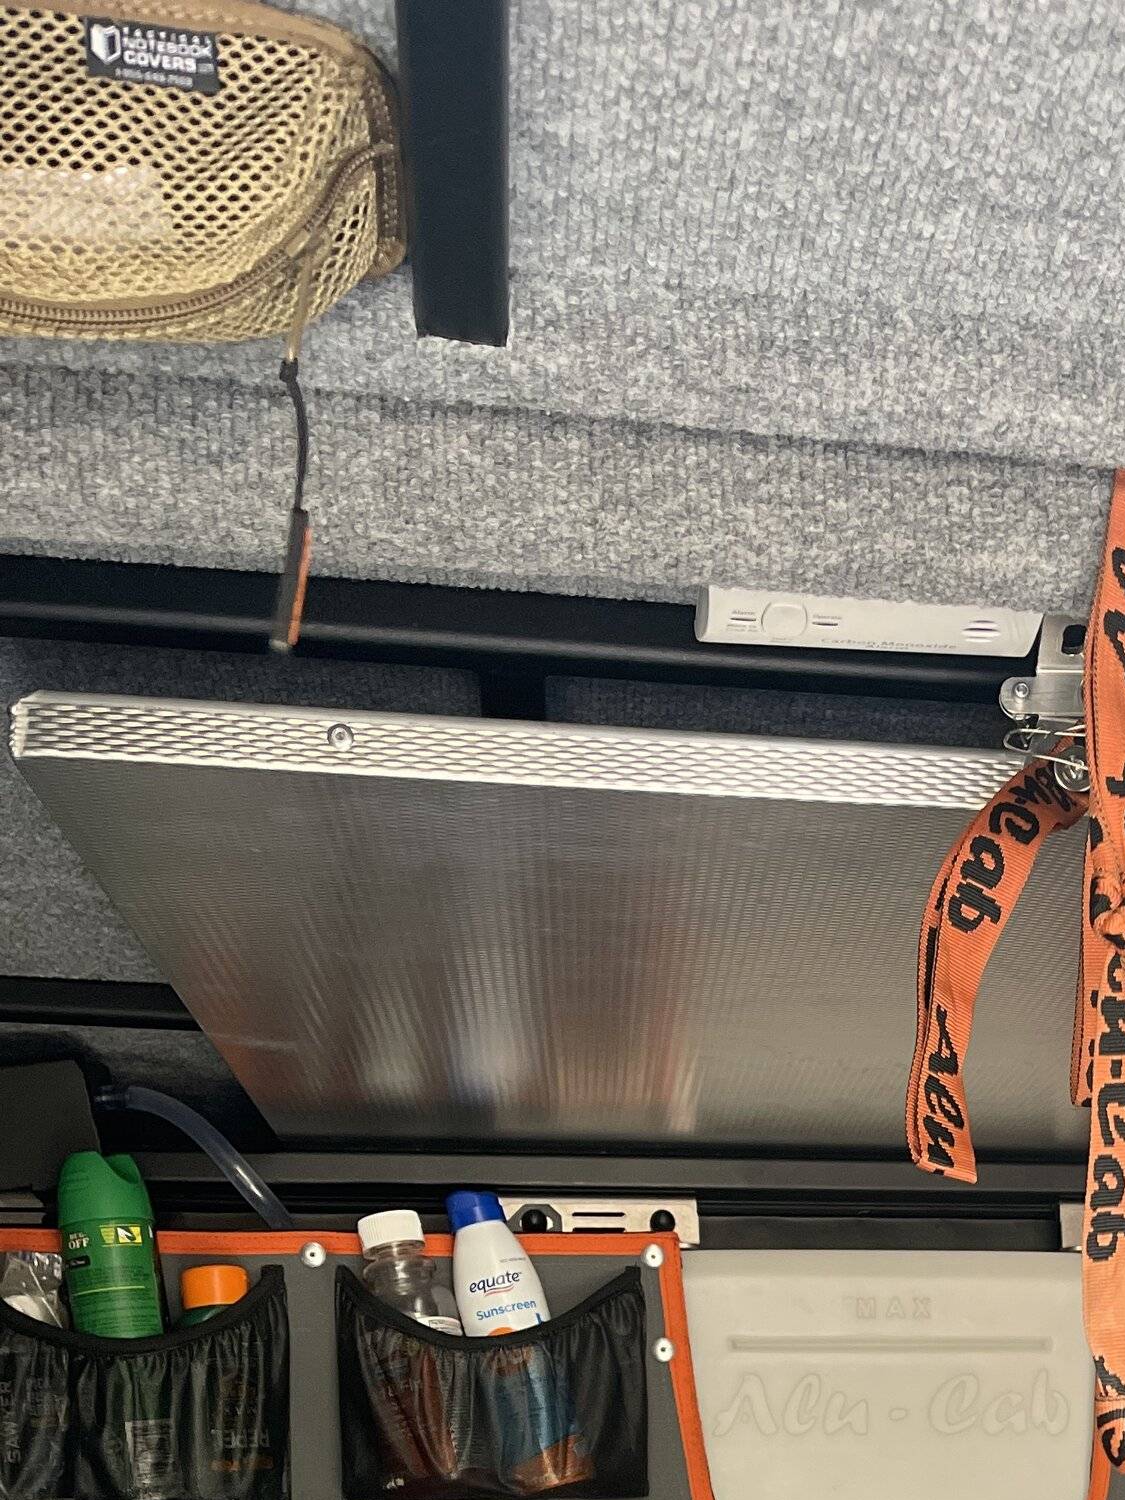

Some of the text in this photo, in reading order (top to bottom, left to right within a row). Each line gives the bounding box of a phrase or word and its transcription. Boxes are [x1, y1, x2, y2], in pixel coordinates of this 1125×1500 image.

[123, 50, 197, 74] COVERS
[68, 1237, 90, 1250] OFF
[469, 1270, 520, 1293] equate
[476, 1300, 537, 1321] Sunscreen
[856, 1297, 933, 1320] MAX
